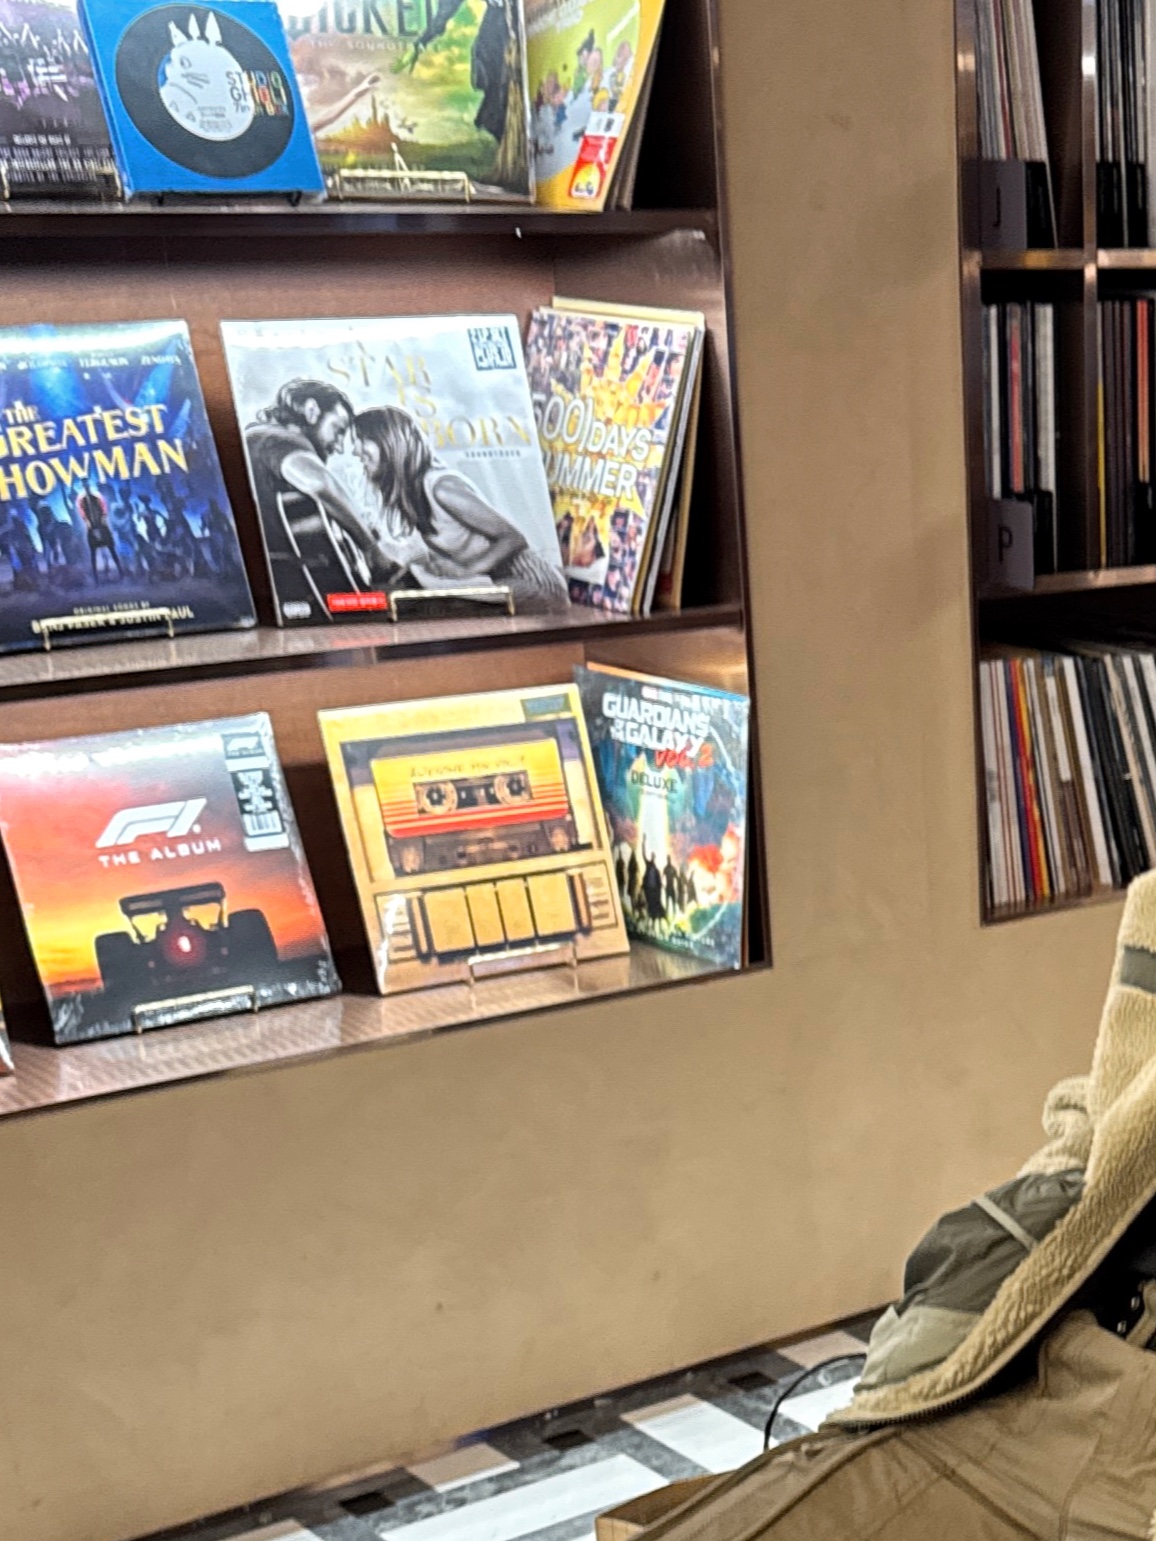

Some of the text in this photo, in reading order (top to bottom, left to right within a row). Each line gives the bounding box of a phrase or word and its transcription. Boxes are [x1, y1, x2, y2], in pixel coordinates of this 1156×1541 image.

[991, 186, 1000, 229] J
[586, 420, 652, 461] DAYS
[0, 438, 189, 502] HOWMAN
[545, 452, 638, 500] UMMER
[997, 526, 1013, 562] P
[602, 691, 710, 737] GUARDIANS
[624, 719, 704, 757] GALAXY
[697, 742, 715, 768] 2
[630, 769, 678, 793] DELUXE
[98, 838, 222, 868] THE ALBUM
